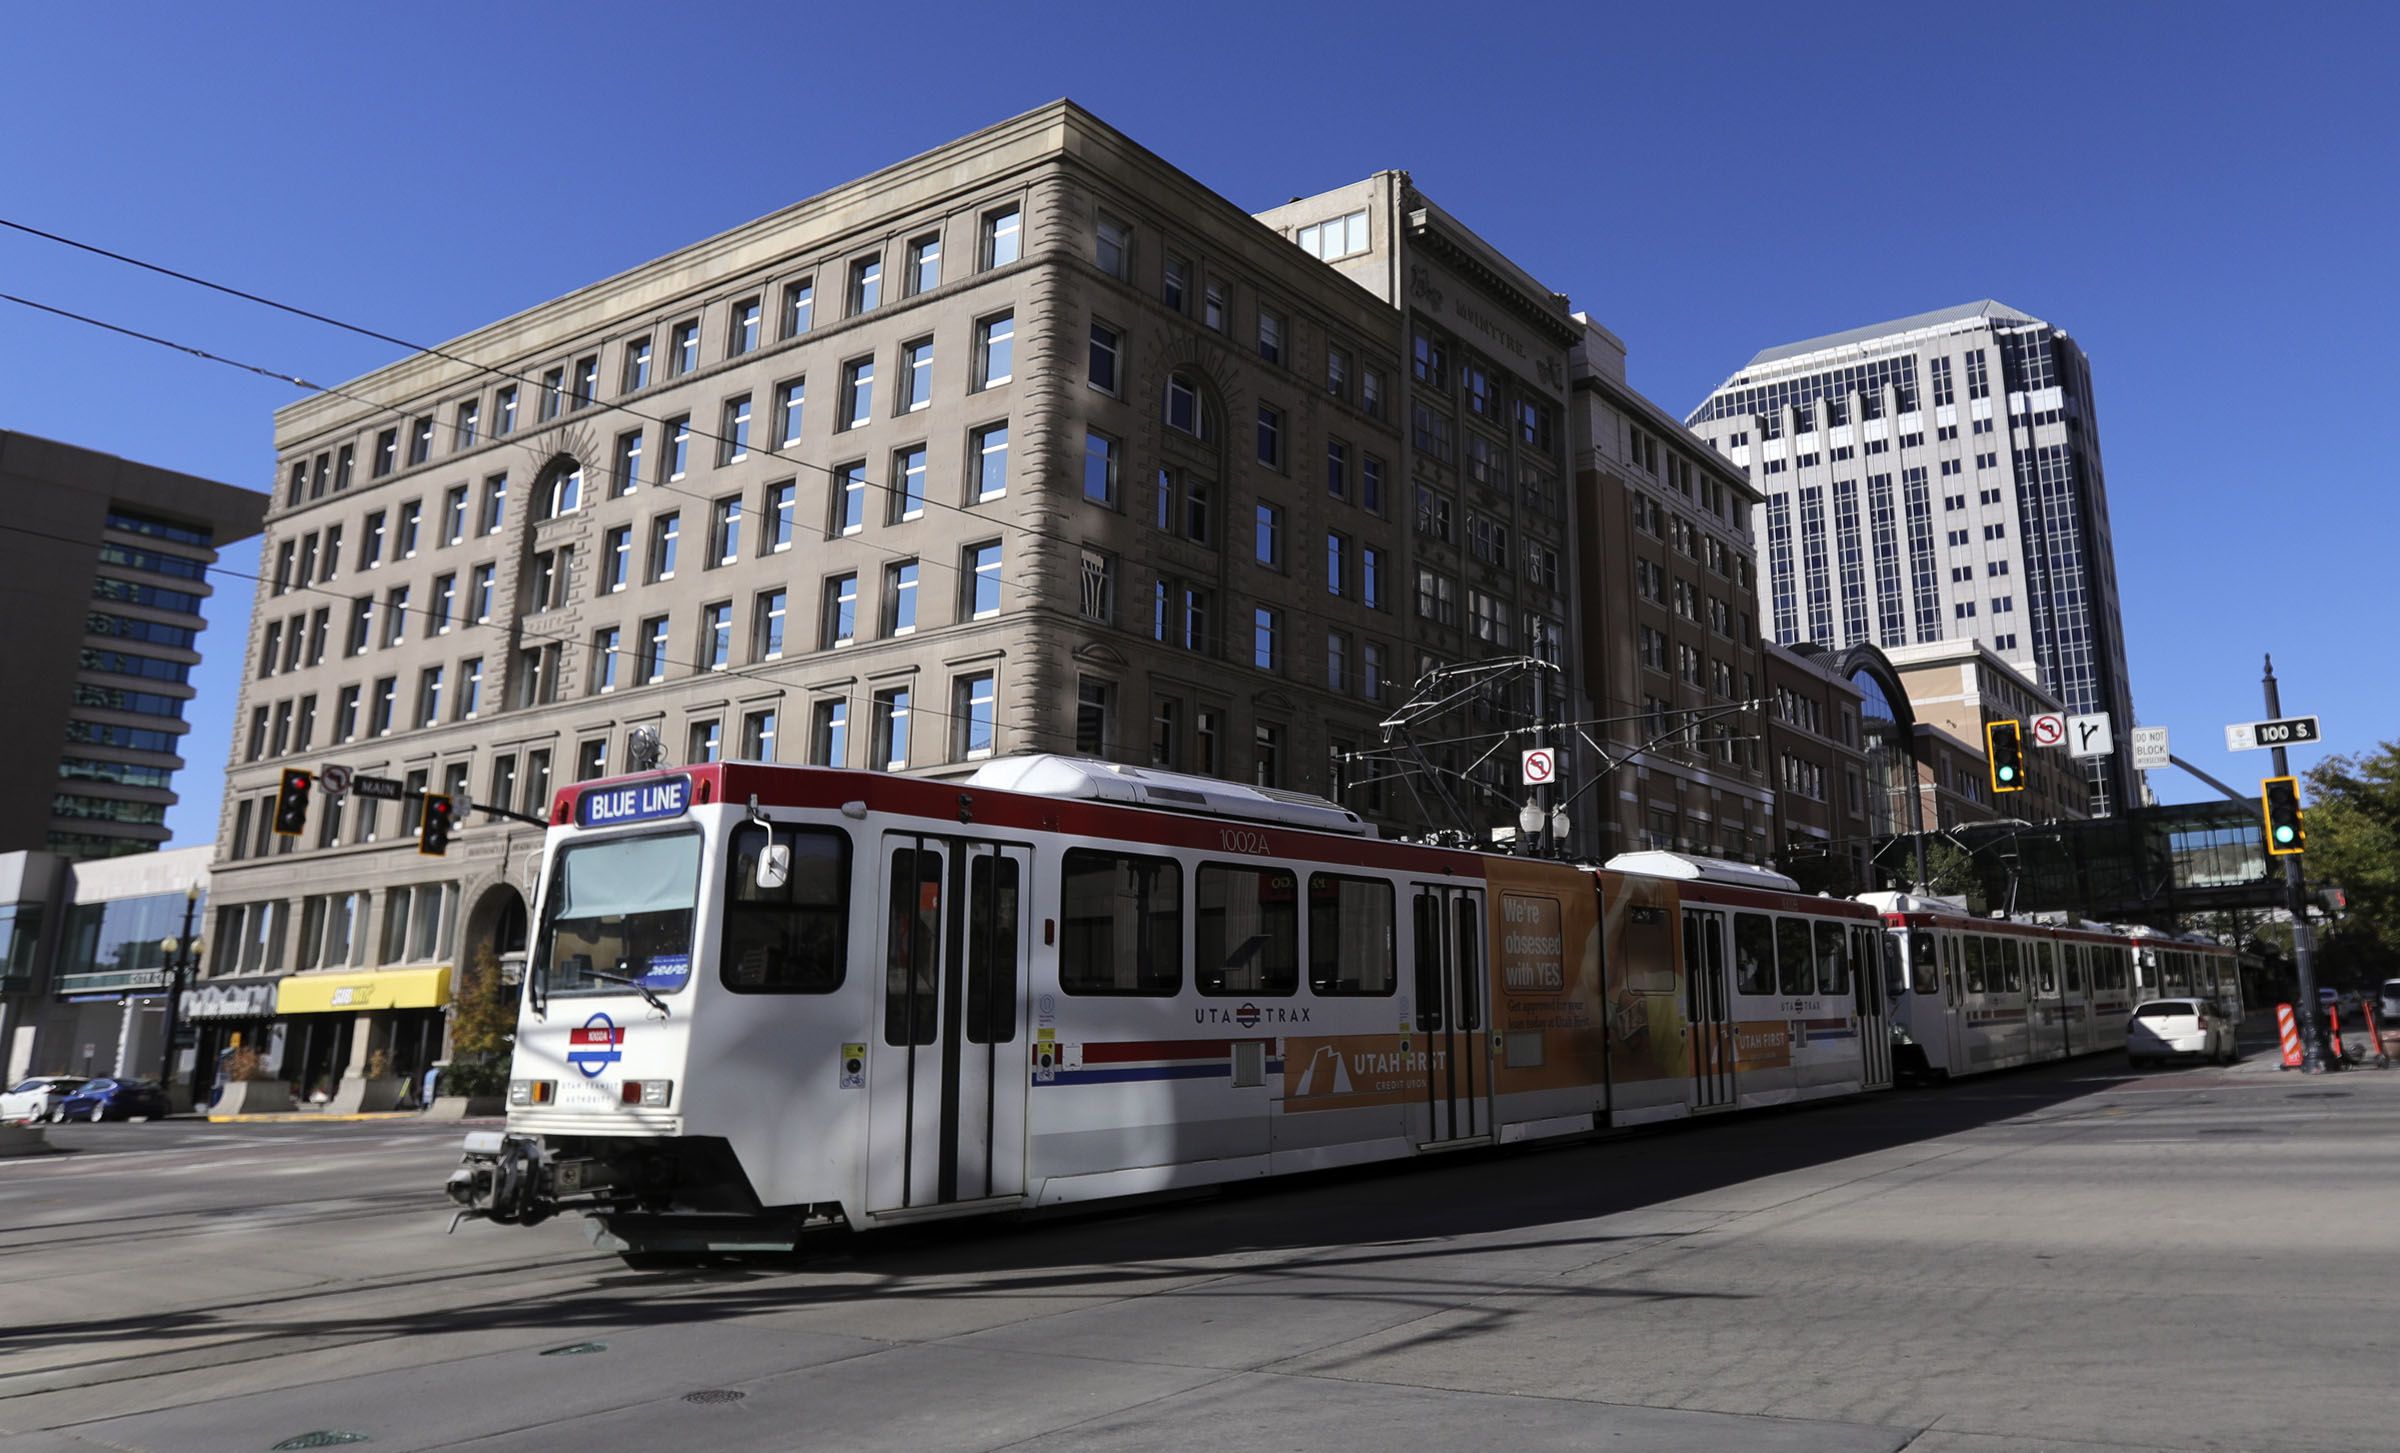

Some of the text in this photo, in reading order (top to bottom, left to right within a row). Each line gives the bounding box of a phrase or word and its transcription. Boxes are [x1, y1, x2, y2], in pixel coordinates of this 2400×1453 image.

[2136, 731, 2164, 743] DO NOT
[2261, 724, 2290, 742] 100
[2137, 745, 2167, 755] BLOCK
[360, 780, 396, 795] MAIN
[592, 783, 682, 820] BLUE LINE
[1219, 828, 1271, 855] 1002A
[1504, 898, 1540, 923] We're
[1505, 931, 1562, 955] obsessed
[1506, 961, 1534, 986] with
[1195, 1008, 1311, 1024] UTA TRAX
[1739, 1032, 1785, 1049] UTAH FIRST
[1354, 1053, 1400, 1075] UTAH
[1376, 1079, 1404, 1091] CREDIT
